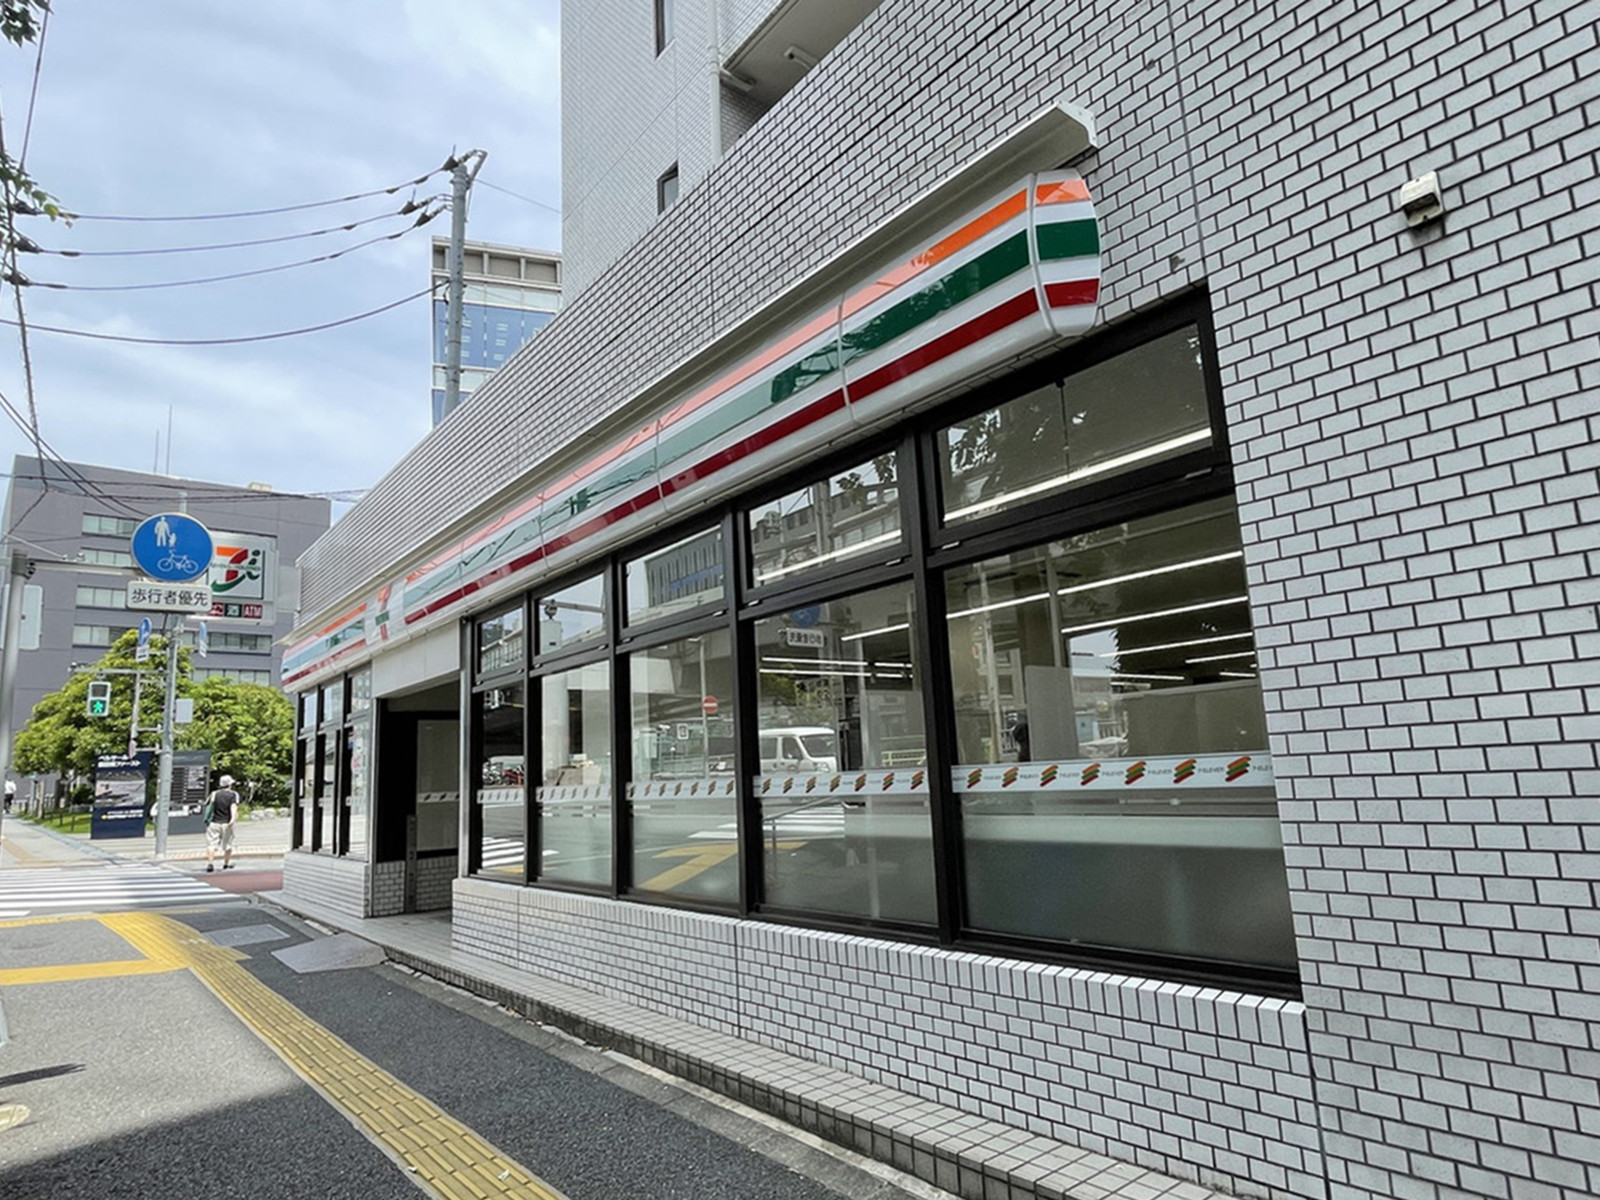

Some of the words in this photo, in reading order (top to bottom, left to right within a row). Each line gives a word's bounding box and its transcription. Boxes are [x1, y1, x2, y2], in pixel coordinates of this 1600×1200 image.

[131, 588, 208, 607] 歩行者優先
[244, 605, 262, 617] ATM
